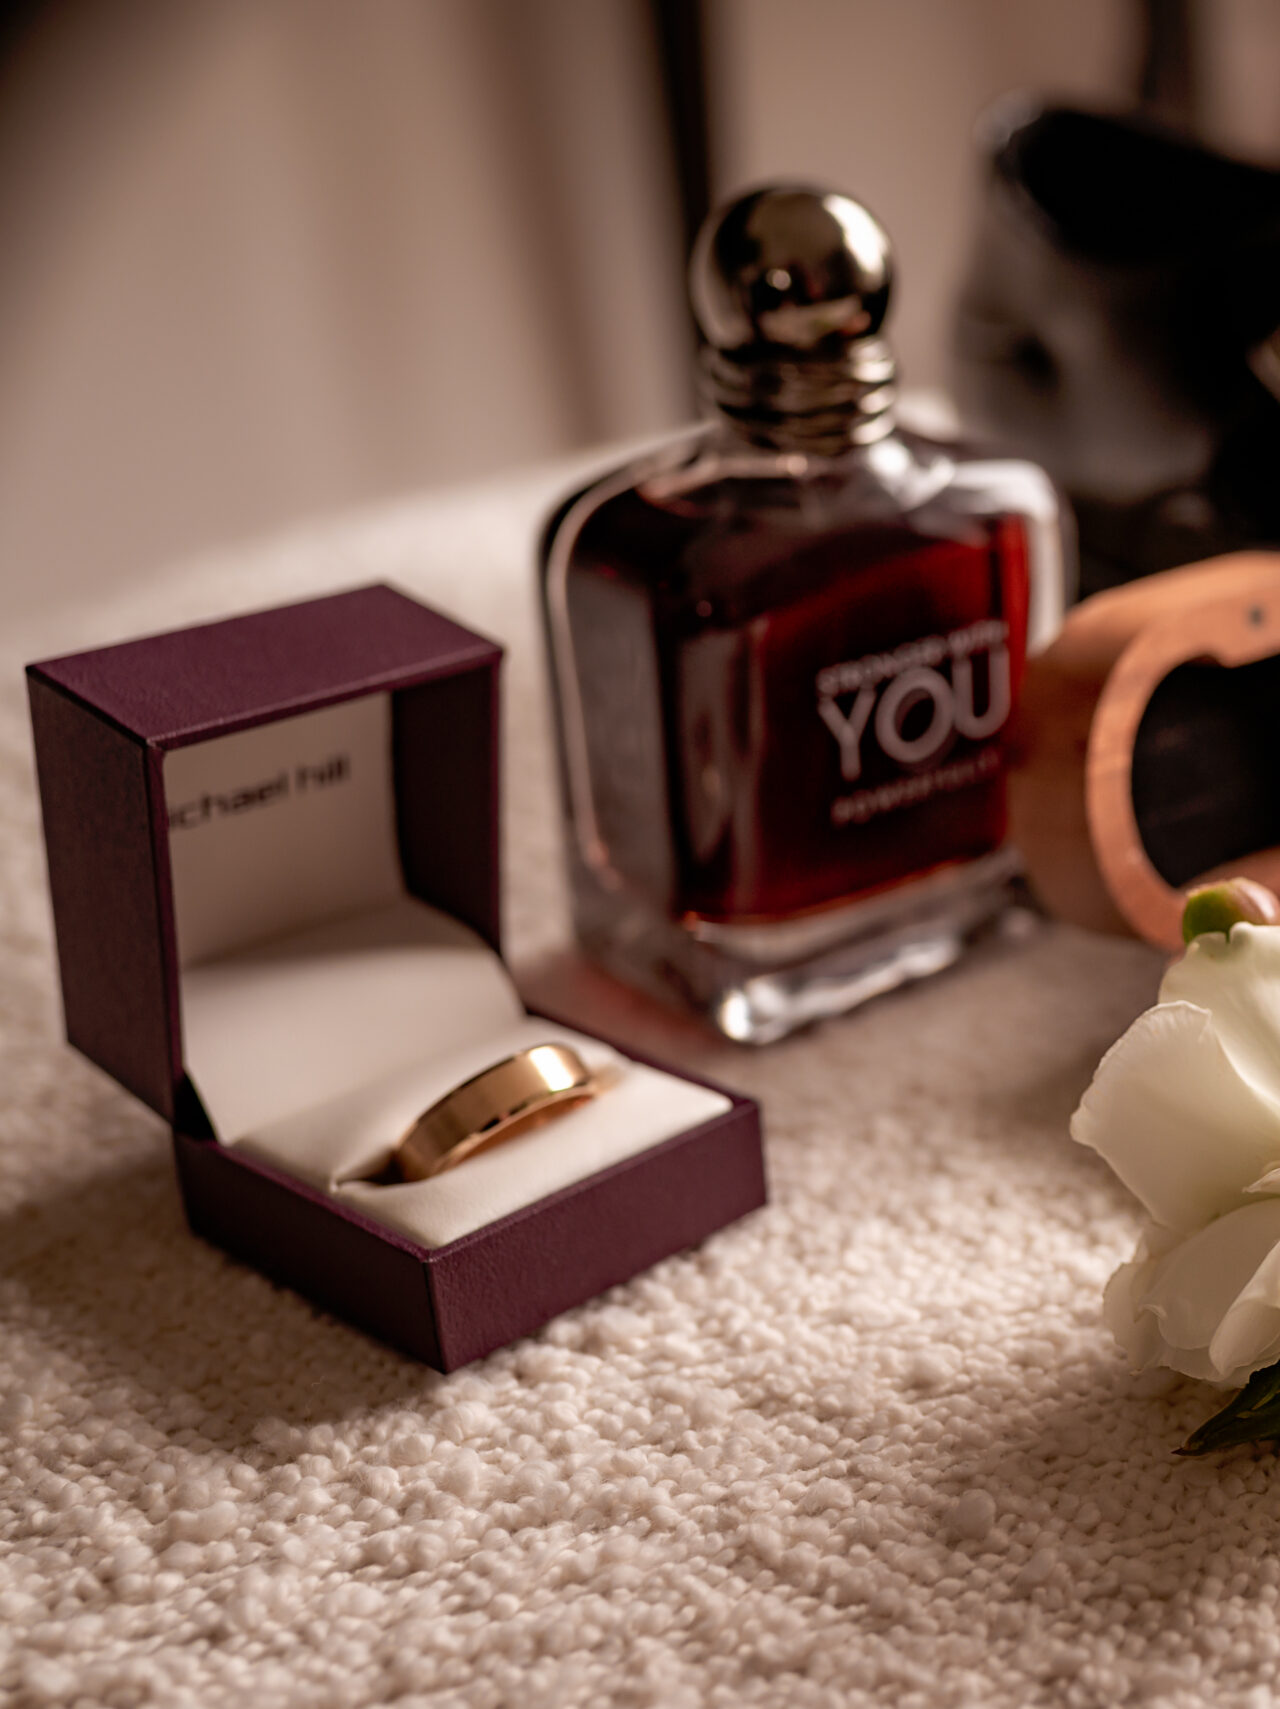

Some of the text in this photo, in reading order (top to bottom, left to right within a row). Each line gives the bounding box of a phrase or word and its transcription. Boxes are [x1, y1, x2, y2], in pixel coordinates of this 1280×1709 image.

[817, 644, 1011, 781] YOU
[169, 756, 349, 829] ichael hill
